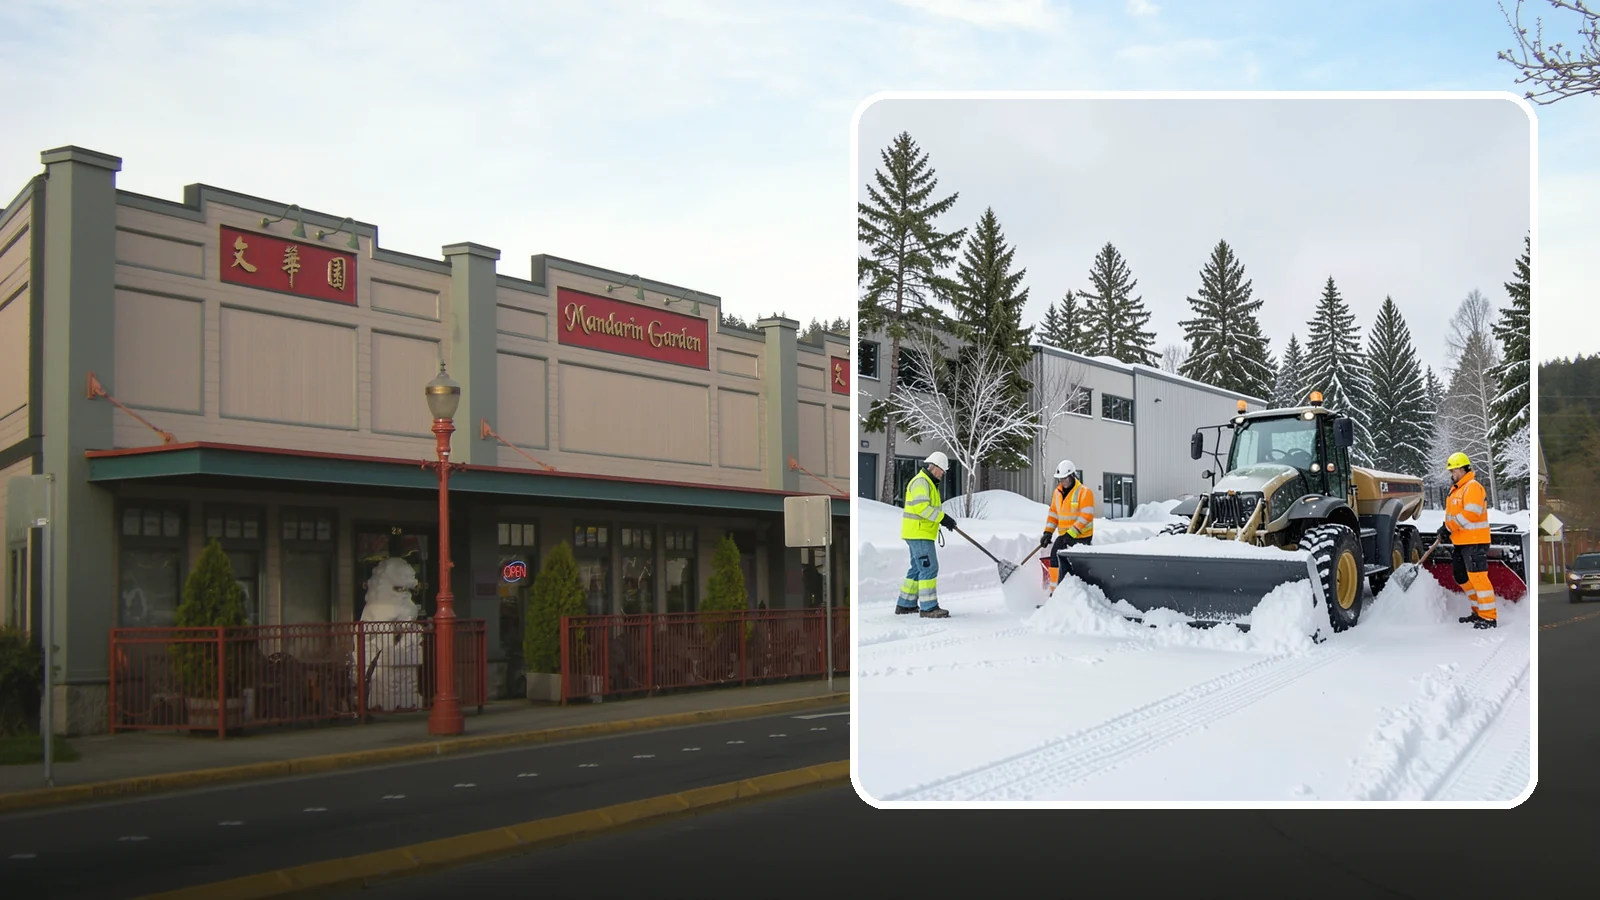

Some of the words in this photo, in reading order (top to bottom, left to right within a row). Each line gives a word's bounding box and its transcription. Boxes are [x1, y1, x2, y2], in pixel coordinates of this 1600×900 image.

[231, 236, 346, 290] 文華園
[565, 302, 644, 341] Mandarin
[648, 320, 701, 352] Garden
[503, 565, 527, 578] OPEN
